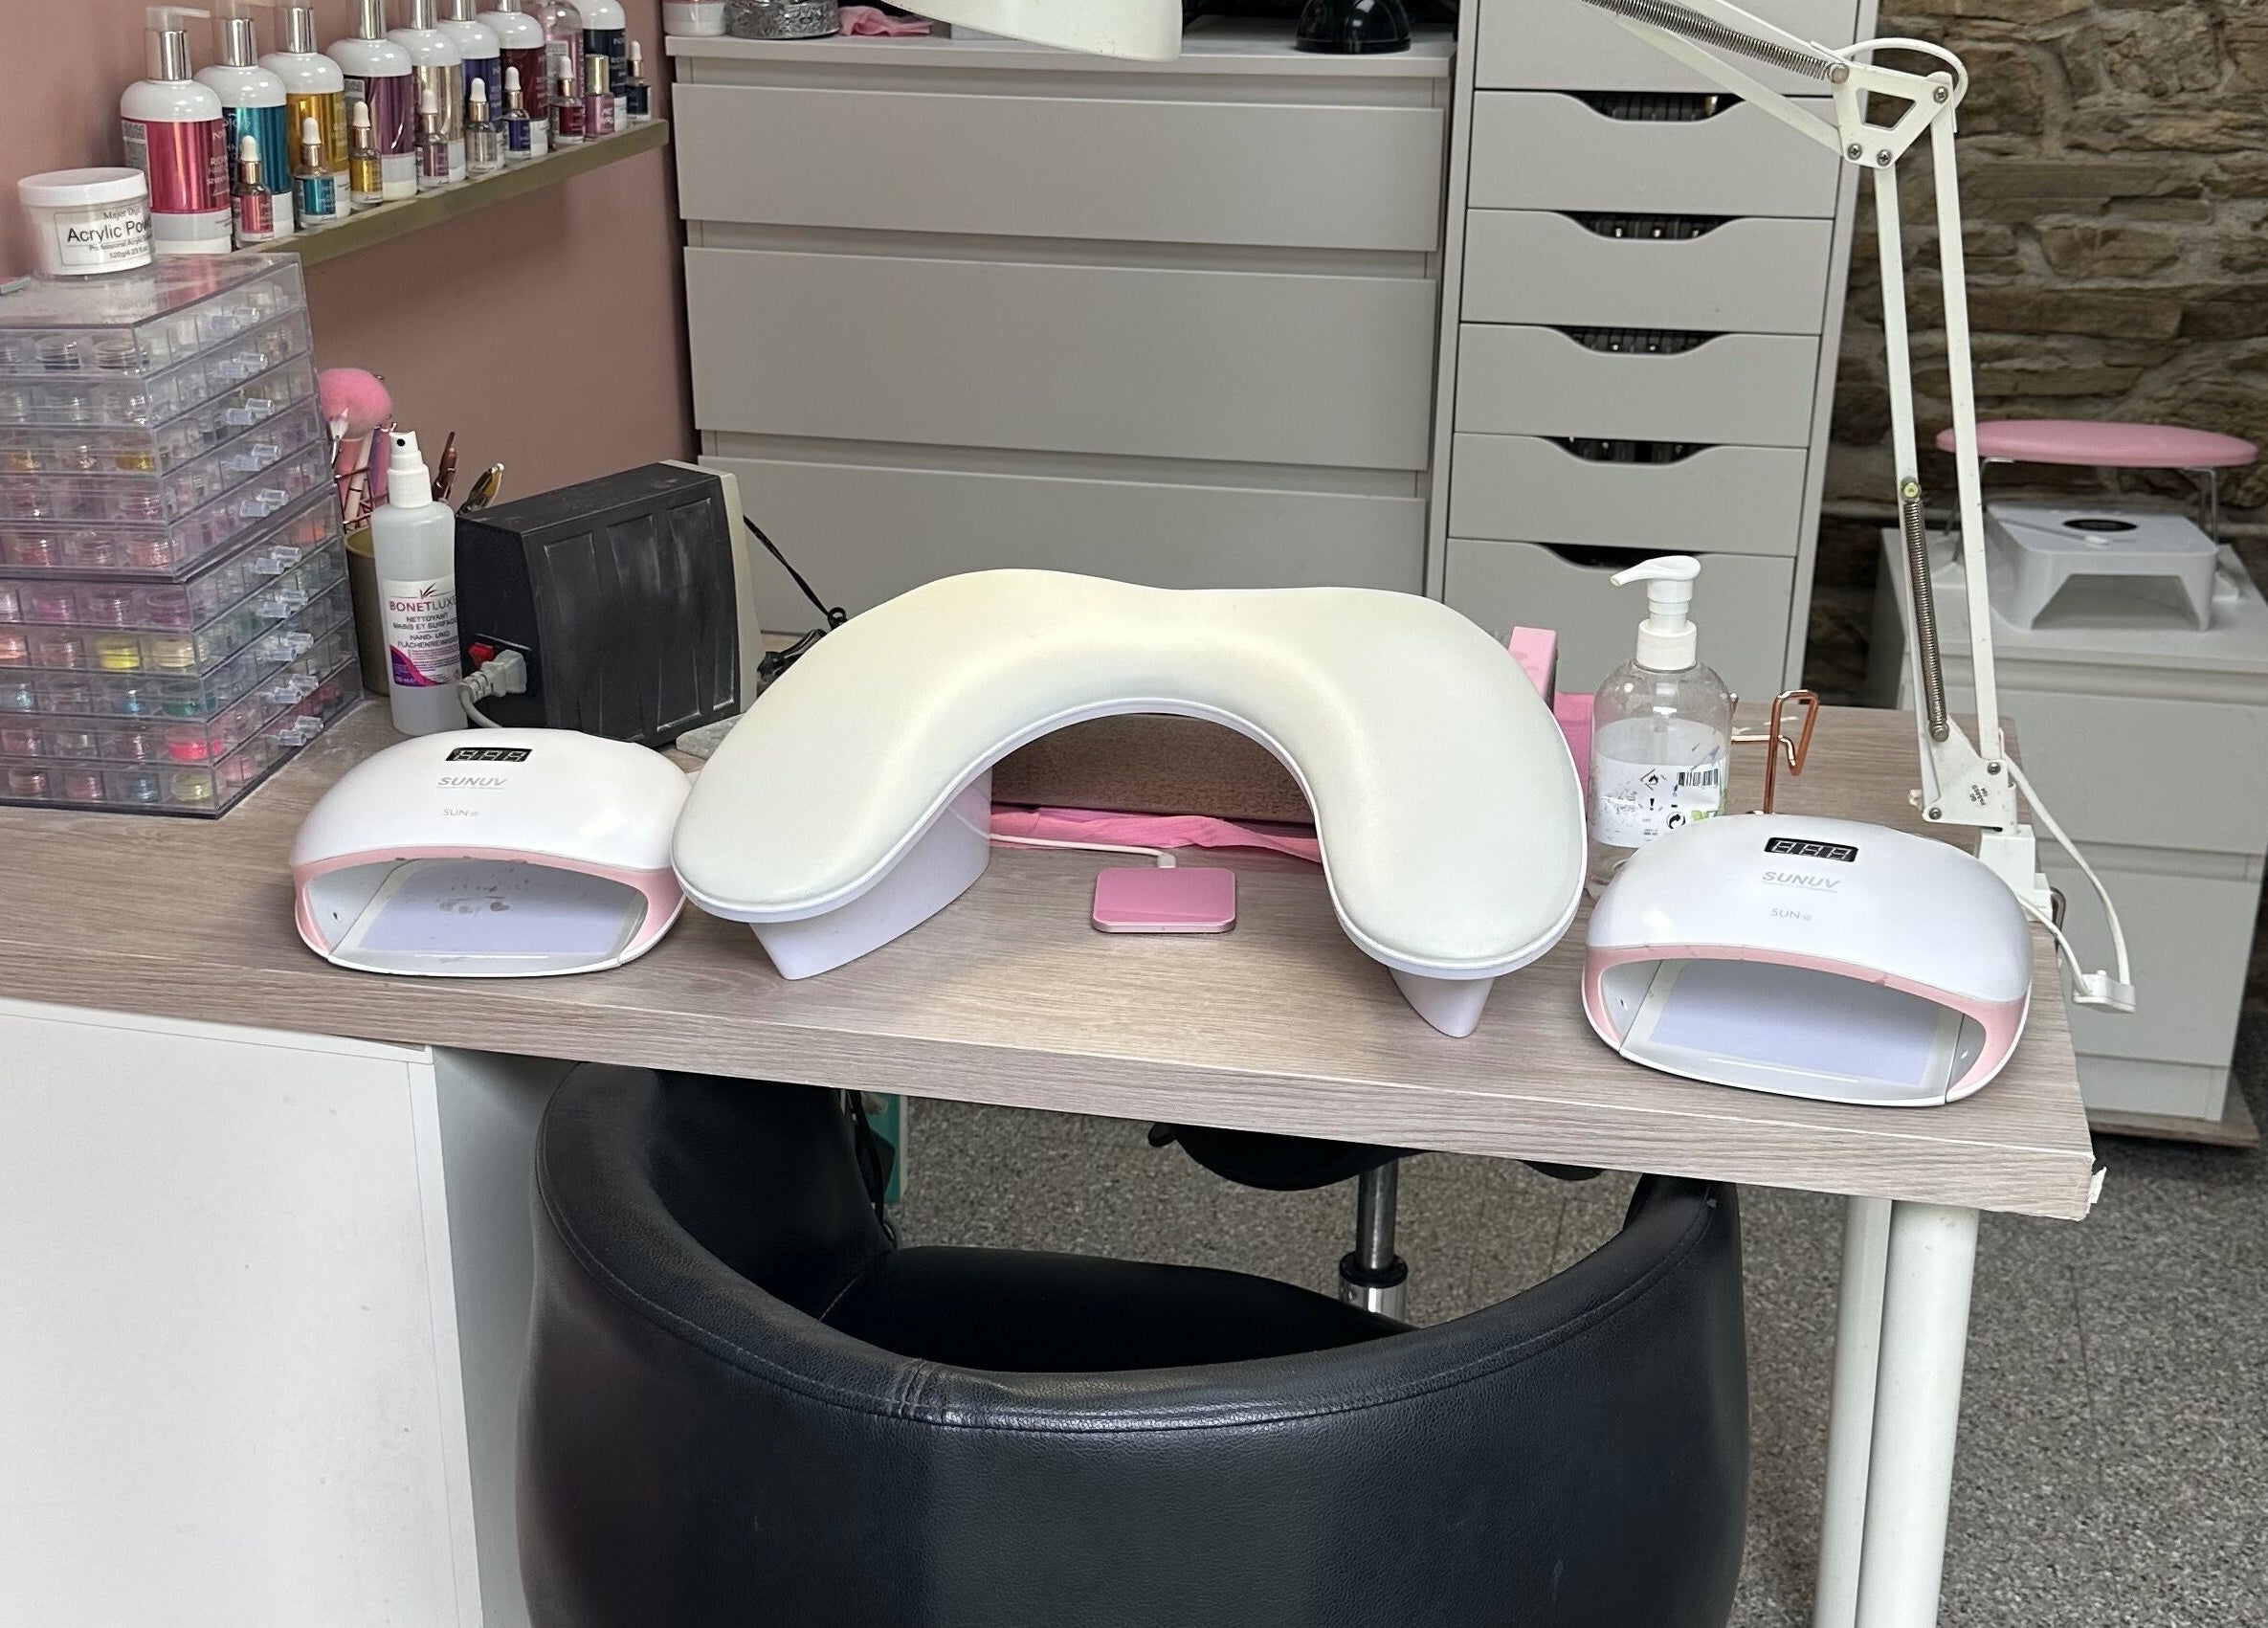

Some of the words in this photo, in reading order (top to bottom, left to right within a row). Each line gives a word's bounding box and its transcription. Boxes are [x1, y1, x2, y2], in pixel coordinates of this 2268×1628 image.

[67, 225, 122, 243] Acrylic
[438, 776, 509, 787] SUNUV
[443, 808, 469, 816] SUN
[1762, 871, 1841, 888] SUNUV
[1770, 907, 1800, 920] SUN
